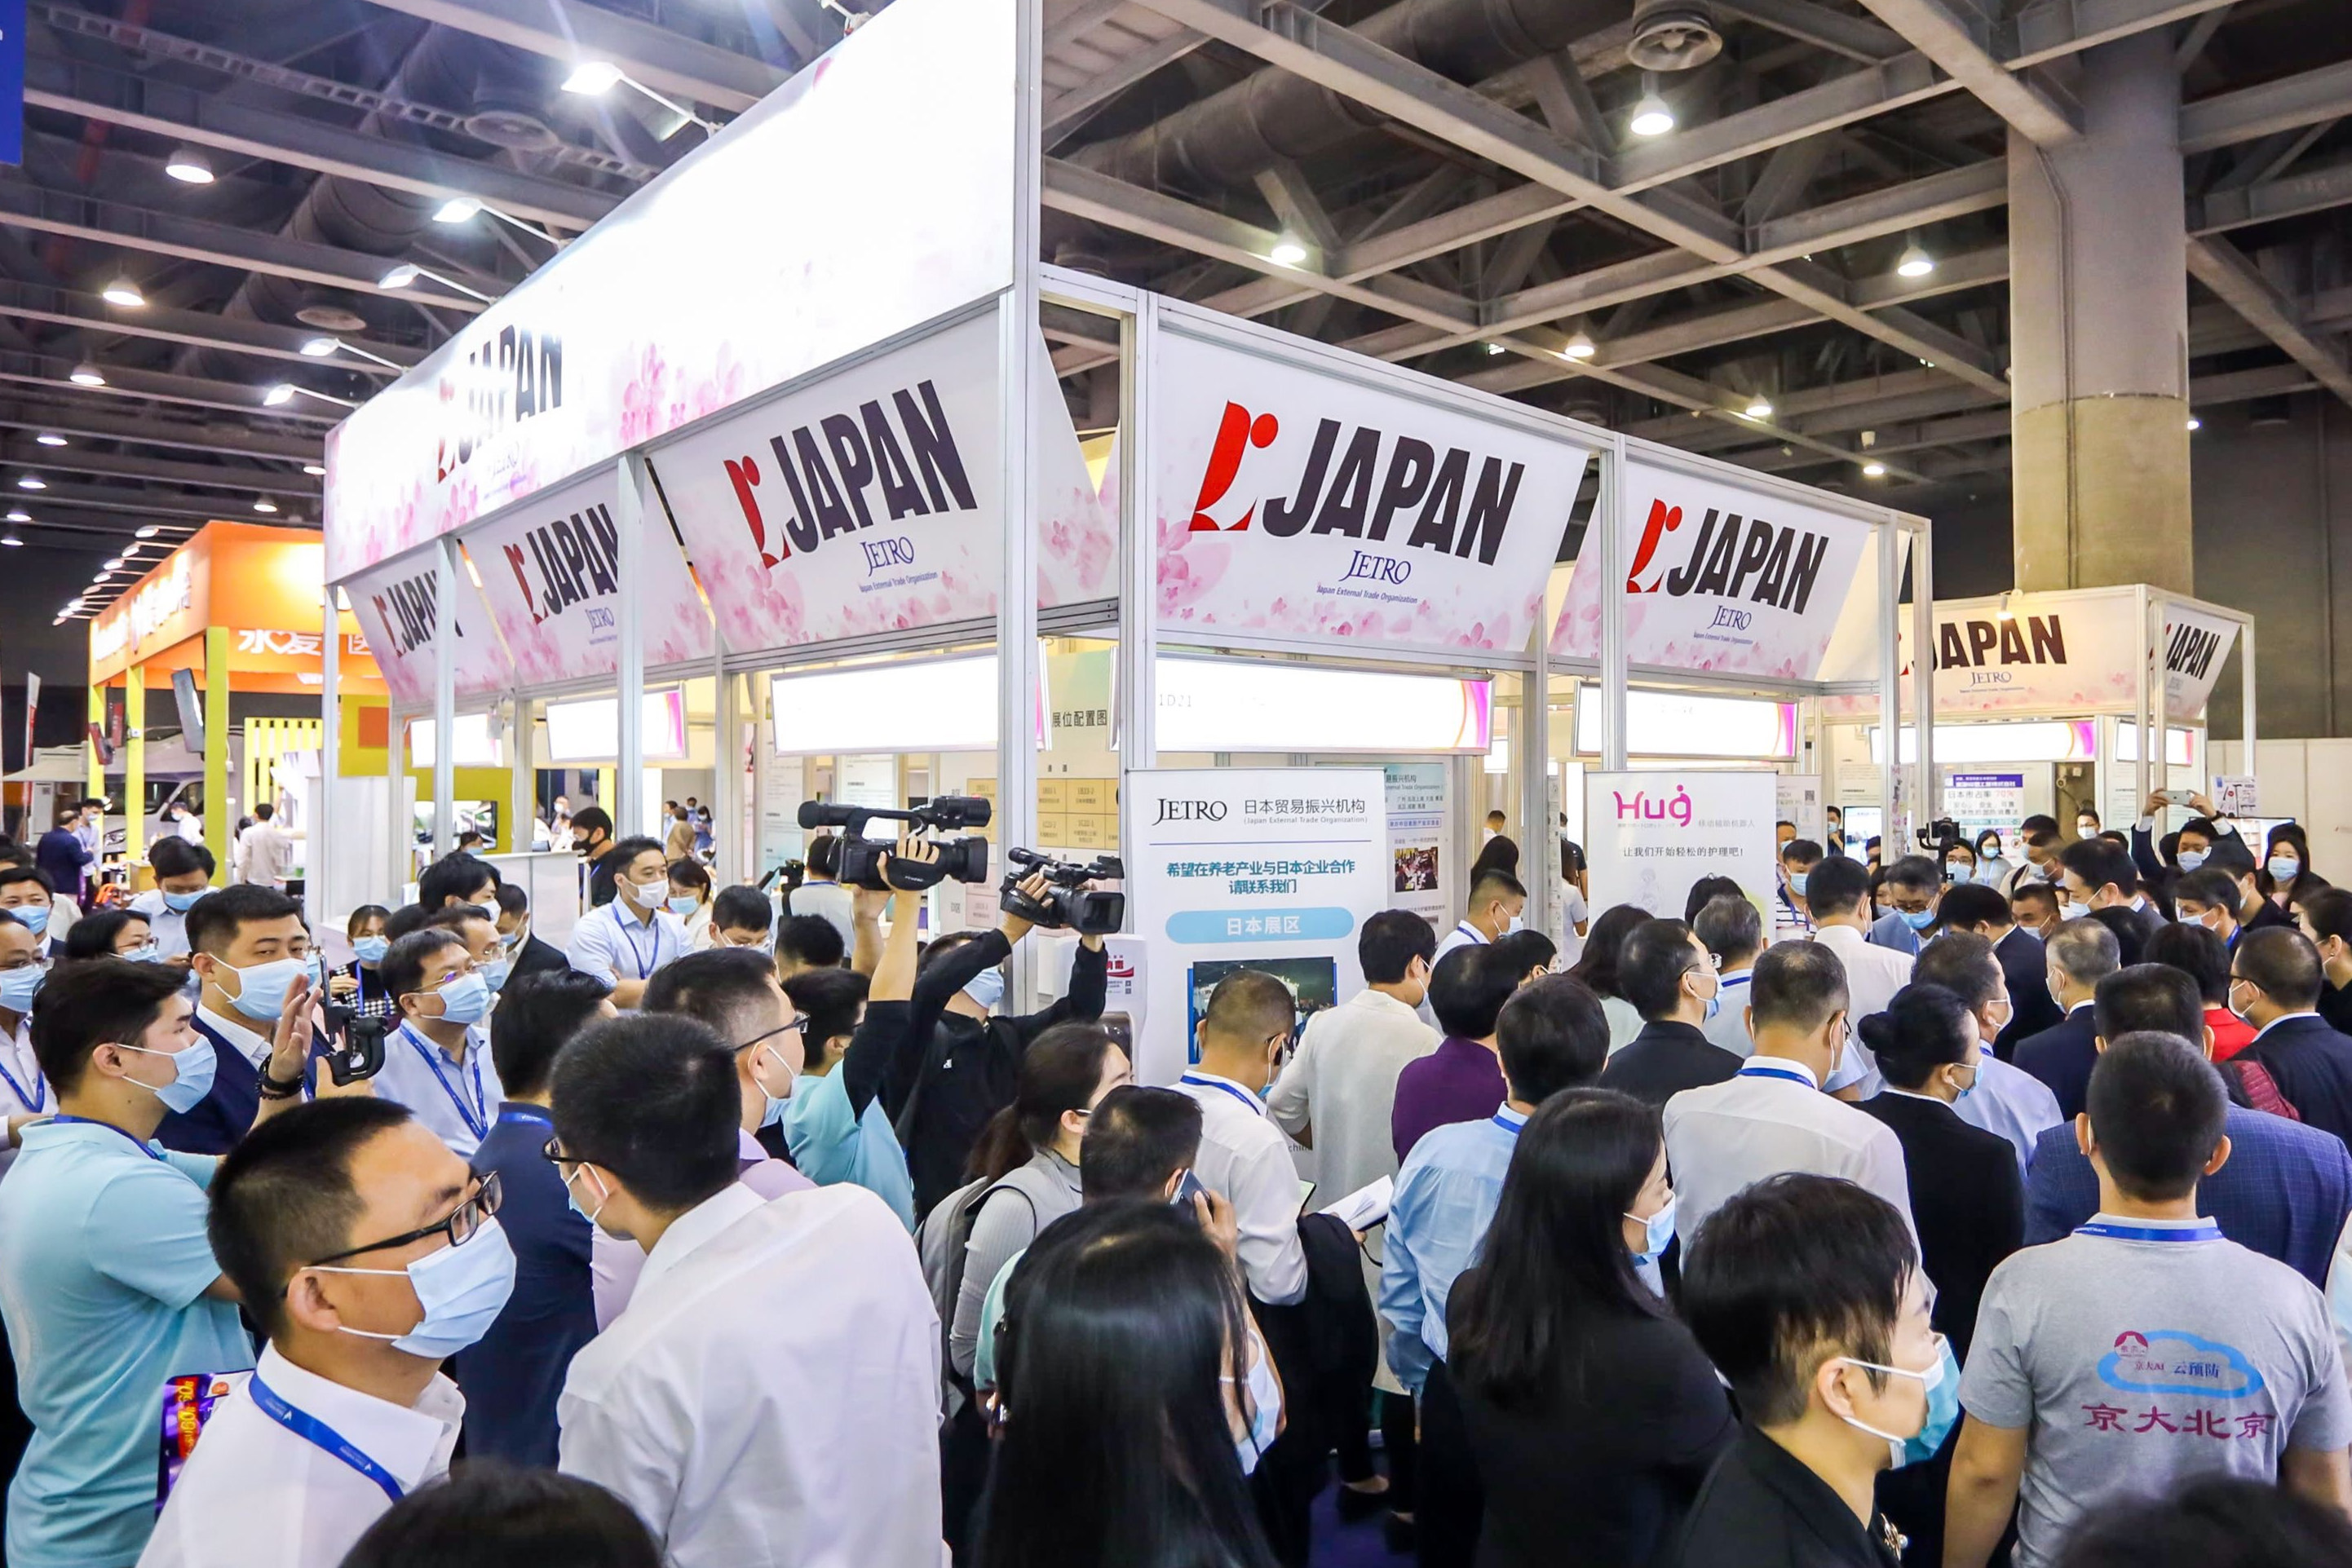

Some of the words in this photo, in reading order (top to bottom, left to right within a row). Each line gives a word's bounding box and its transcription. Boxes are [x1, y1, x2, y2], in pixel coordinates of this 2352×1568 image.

[770, 379, 978, 553] JAPAN
[1262, 418, 1525, 566] JAPAN
[860, 537, 914, 576] JETRO
[1339, 550, 1412, 585] JETRO
[1666, 508, 1829, 615] JAPAN
[1317, 585, 1336, 594] Japan
[1337, 587, 1363, 598] External
[1364, 590, 1380, 599] Trade
[1381, 592, 1417, 604] Organization
[1708, 605, 1752, 630] JETRO
[1970, 671, 2012, 687] JETRO
[1052, 709, 1107, 727] 展位配置图
[1152, 798, 1227, 826] JETRO
[1245, 798, 1365, 814] 日本贸易振兴机构
[1612, 784, 1691, 827] Hug
[1166, 859, 1355, 877] 希望在养老产业与日本企业合作
[1229, 879, 1297, 894] 请联系我们
[1227, 916, 1301, 936] 日本展区
[2173, 1362, 2219, 1379] 云预防
[2081, 1403, 2275, 1439] 京大北京
